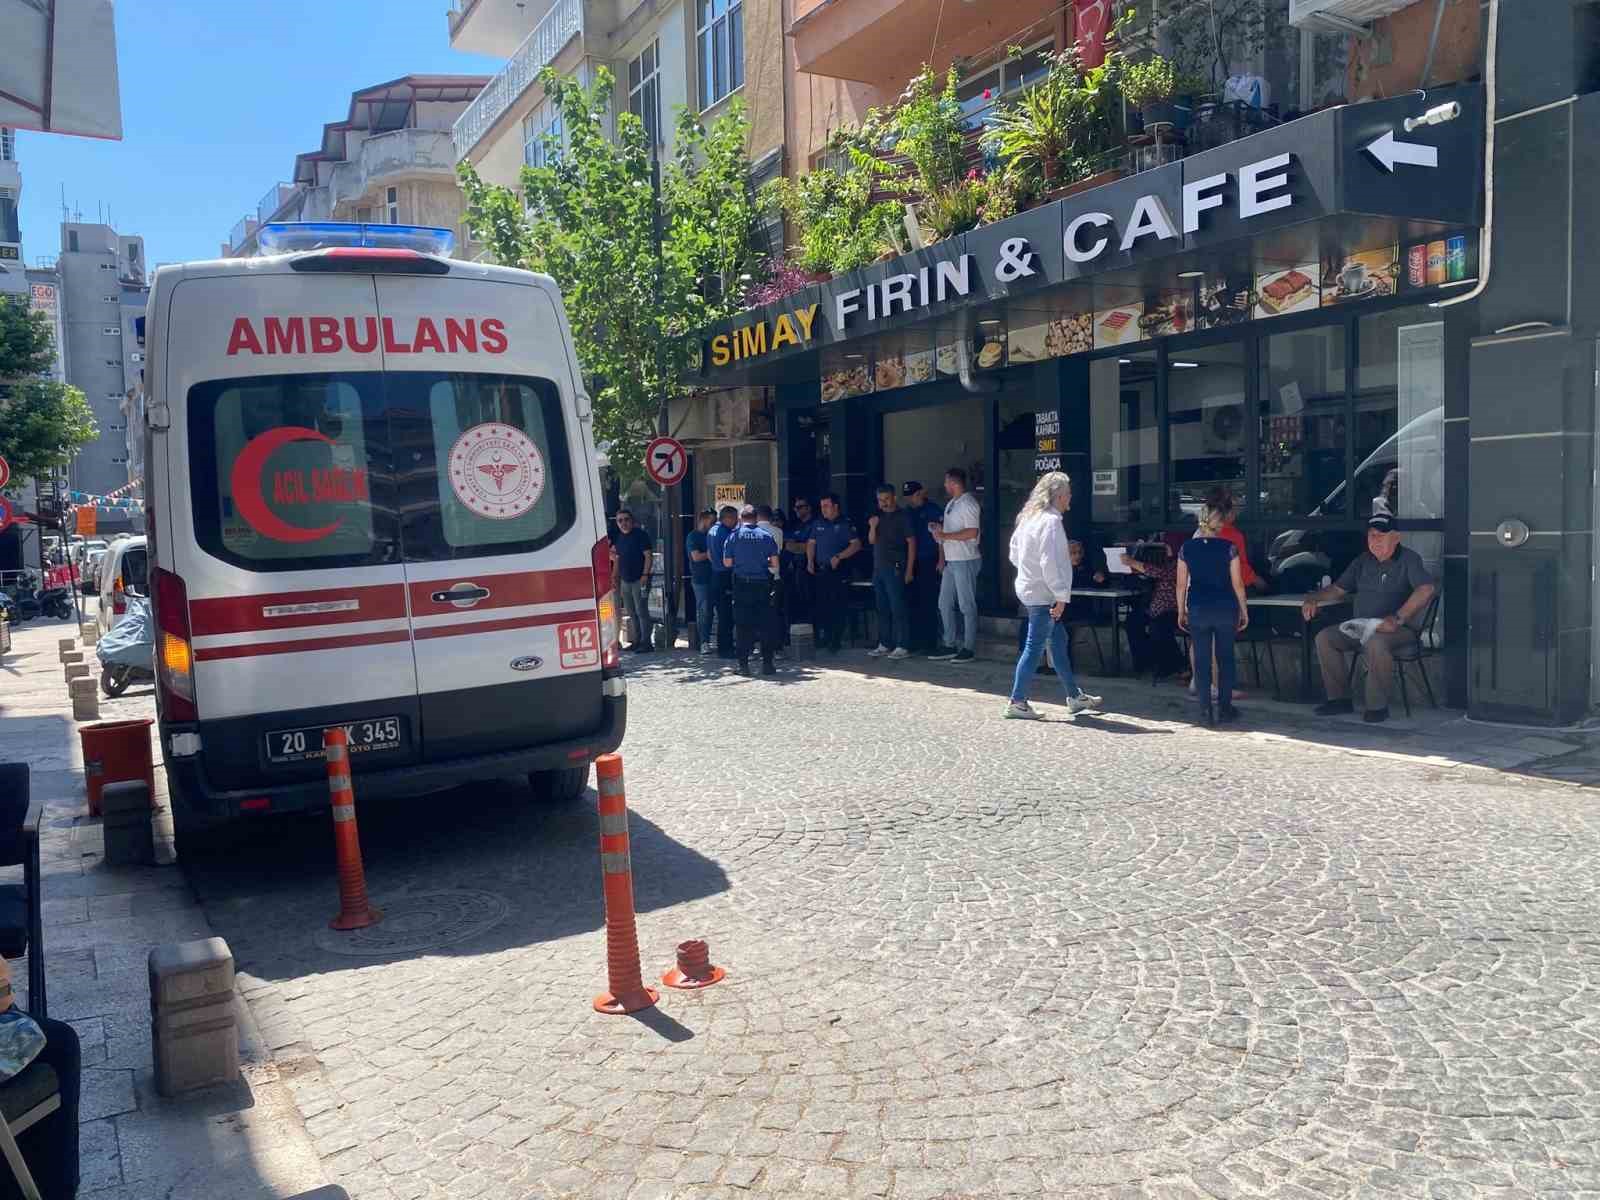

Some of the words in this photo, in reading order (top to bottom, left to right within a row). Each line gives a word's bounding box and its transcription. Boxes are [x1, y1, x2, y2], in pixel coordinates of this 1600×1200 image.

[835, 253, 970, 331] FIRIN
[994, 237, 1036, 282] &
[1063, 152, 1292, 263] CAFE
[226, 316, 508, 355] AMBULANS
[564, 627, 593, 649] 112
[282, 732, 305, 753] 20
[362, 720, 397, 743] 345
